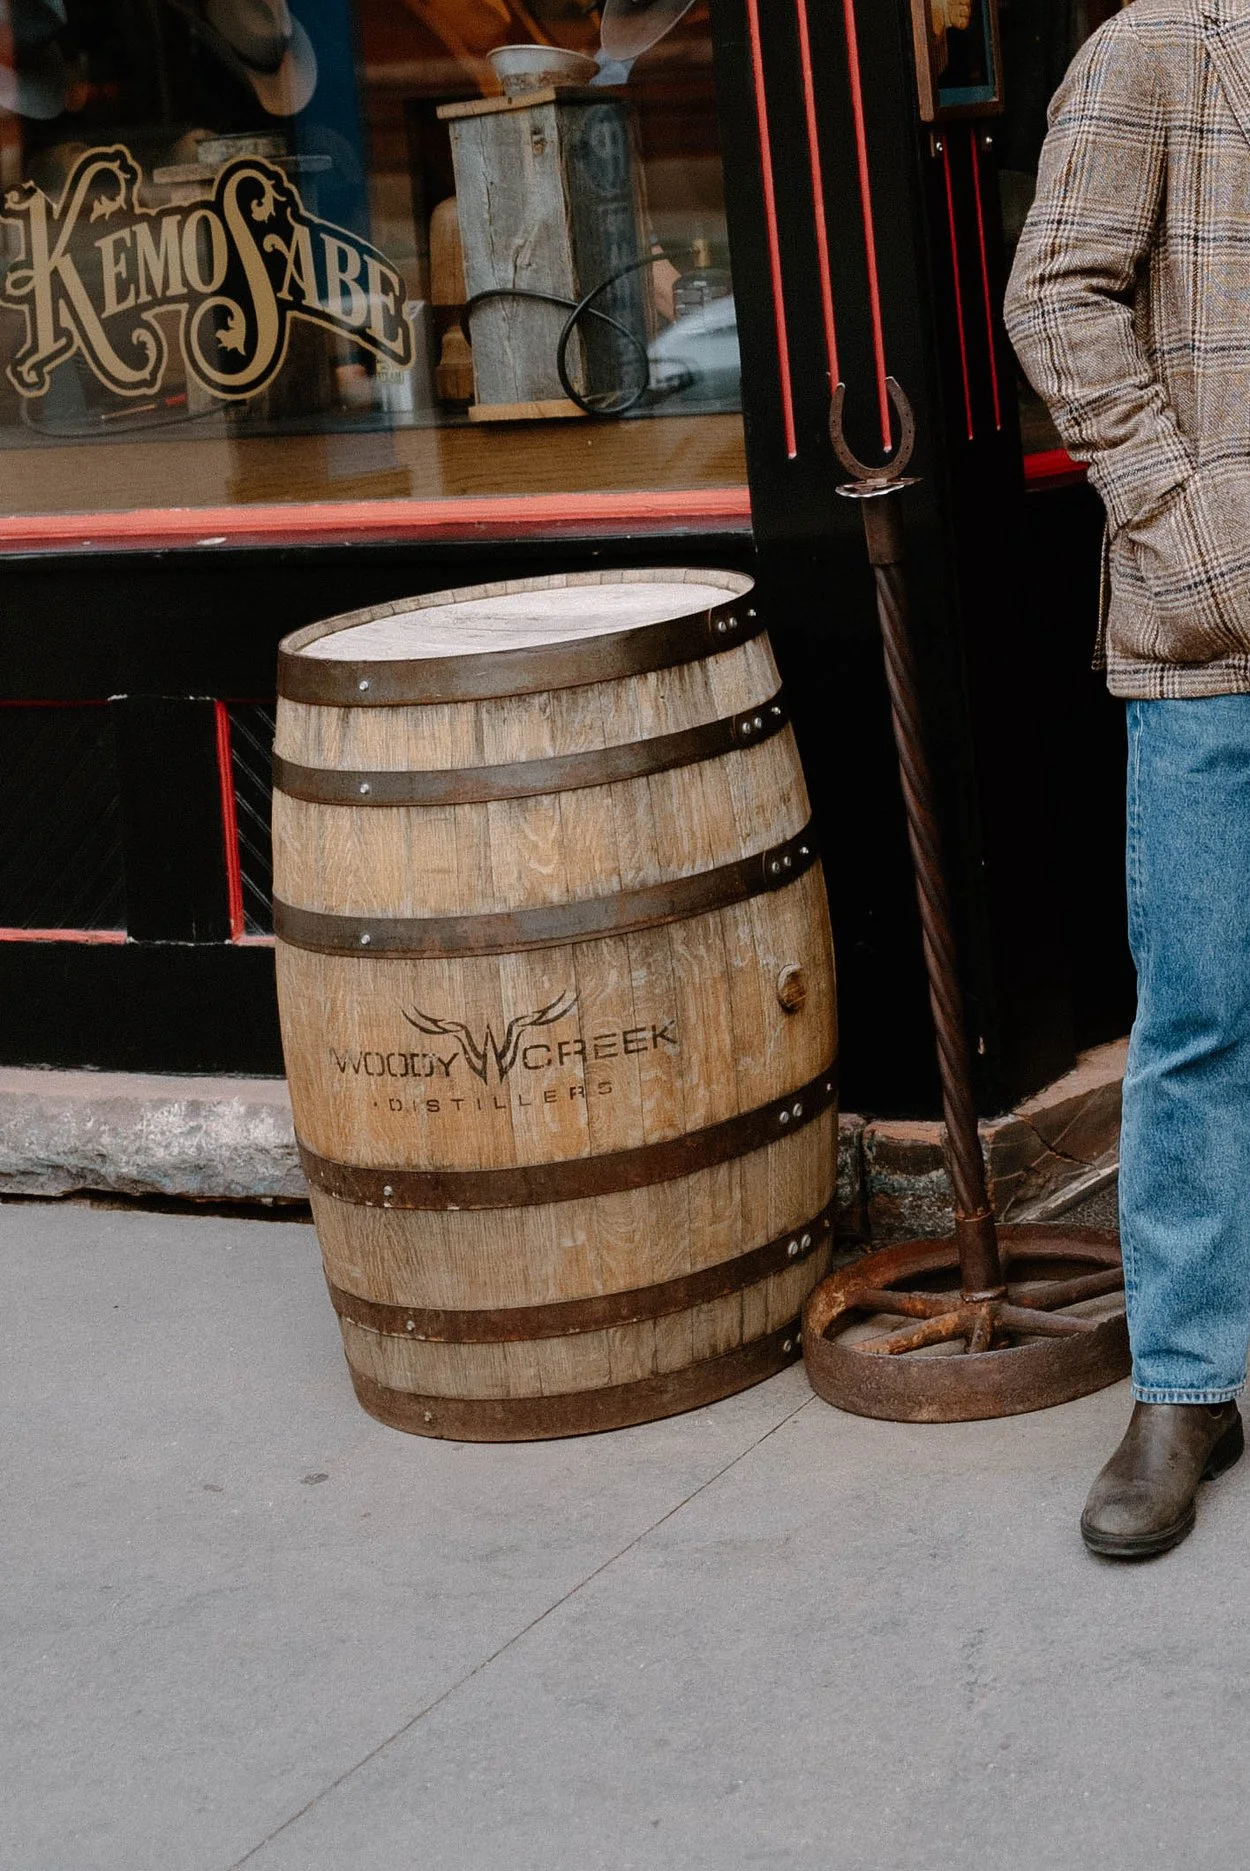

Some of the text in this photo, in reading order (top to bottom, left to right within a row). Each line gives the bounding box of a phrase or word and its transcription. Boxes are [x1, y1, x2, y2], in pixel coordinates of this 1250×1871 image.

[330, 1047, 459, 1078] WOODY
[522, 1019, 681, 1071] CREEK
[388, 1080, 614, 1113] DISTILLERS
